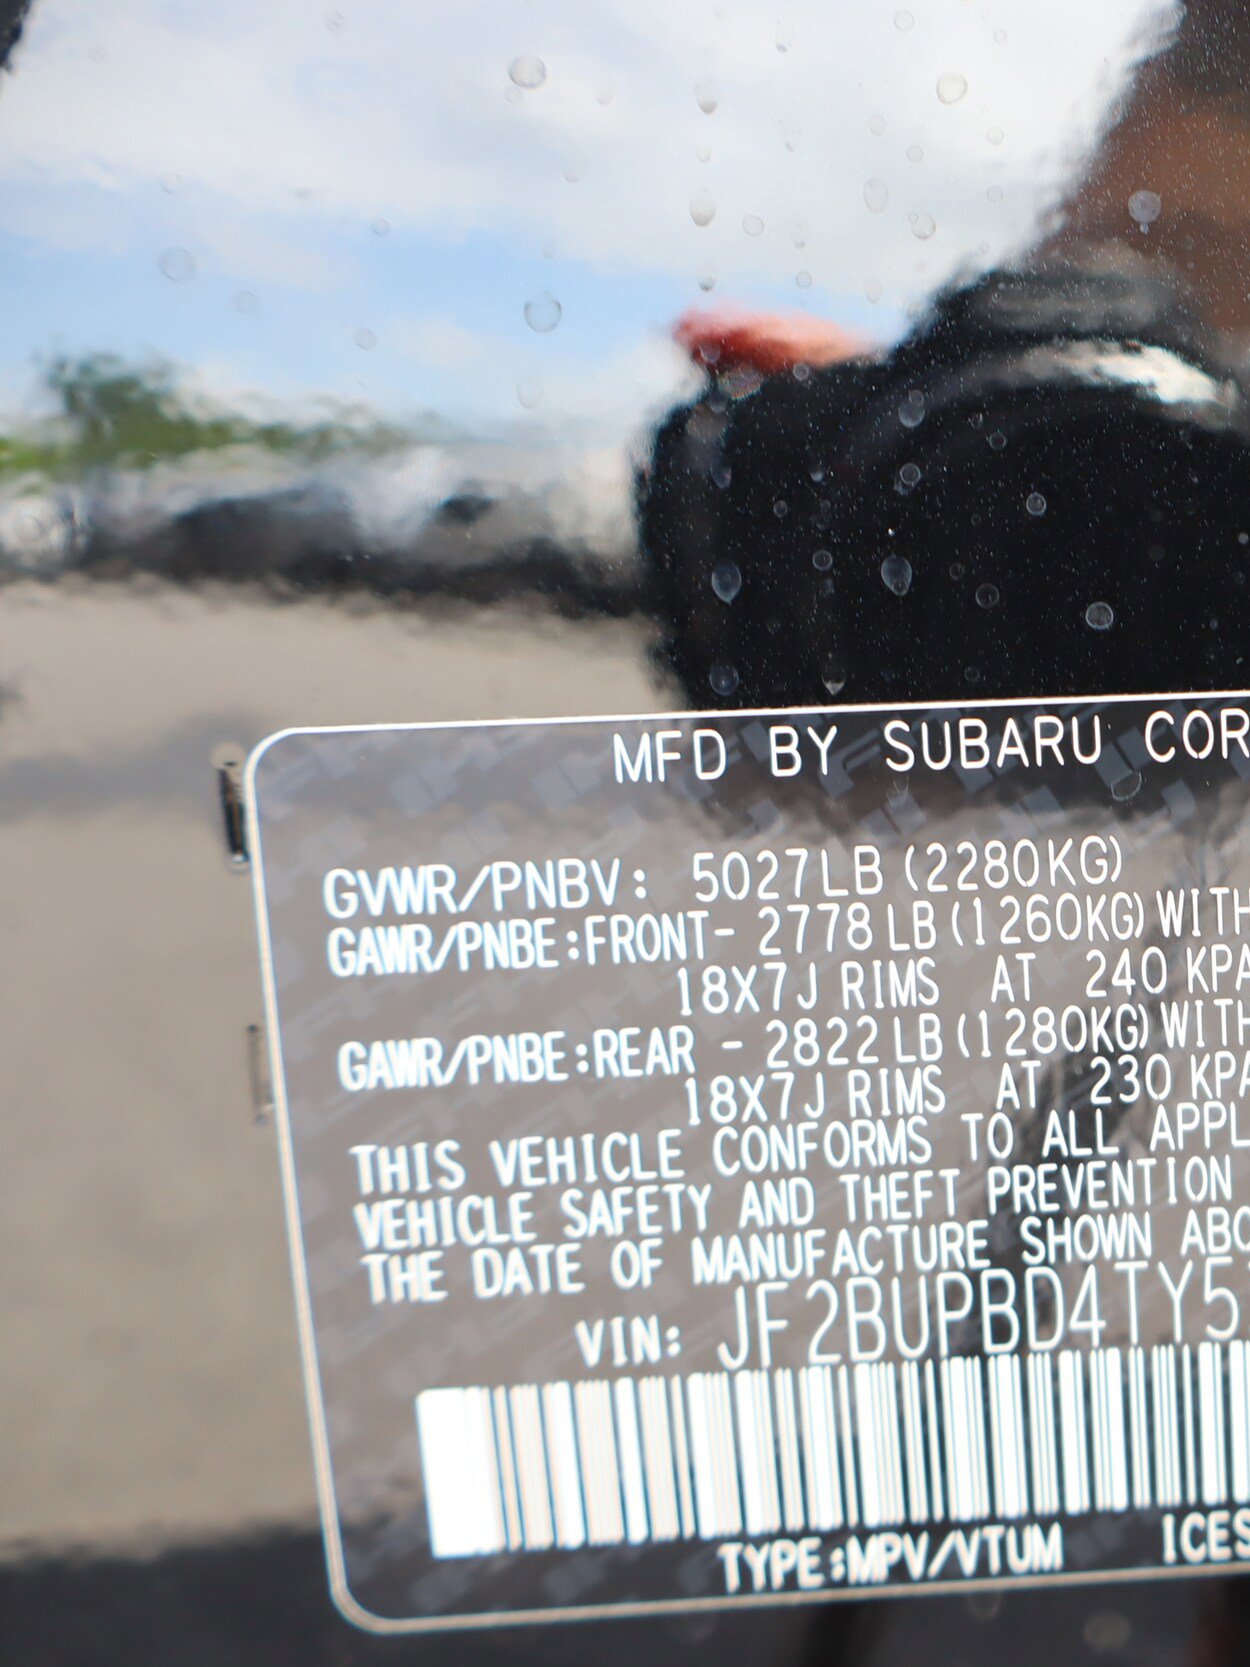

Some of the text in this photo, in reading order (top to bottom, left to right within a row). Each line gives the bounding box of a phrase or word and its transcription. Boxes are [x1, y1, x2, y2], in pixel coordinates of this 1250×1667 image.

[614, 731, 726, 783] MFD
[770, 726, 836, 776] BY
[885, 715, 1101, 771] SUBARU
[324, 859, 646, 919] GVWR/PNBV:
[842, 958, 939, 1010] RIMS
[991, 954, 1036, 1002] AT
[1086, 946, 1167, 998] 240
[848, 1066, 945, 1119] RIMS
[997, 1061, 1042, 1109] AT
[1091, 1055, 1171, 1104] 230
[350, 1140, 465, 1194] THIS
[490, 1129, 684, 1186] VEHICLE
[714, 1116, 932, 1176] CONFORMS
[961, 1112, 1014, 1161] TO
[1043, 1109, 1119, 1156] ALL
[355, 1192, 536, 1248] VEHICLE
[562, 1184, 711, 1238] SAFETY
[740, 1178, 814, 1228] AND
[840, 1169, 961, 1221] THEFT
[987, 1155, 1232, 1215] PREVENTION
[361, 1250, 448, 1303] THE
[473, 1244, 586, 1299] DATE
[612, 1239, 662, 1288] OF
[692, 1221, 991, 1285] MANUFACTURE
[1021, 1211, 1152, 1265] SHOWN
[574, 1314, 681, 1369] VIN:
